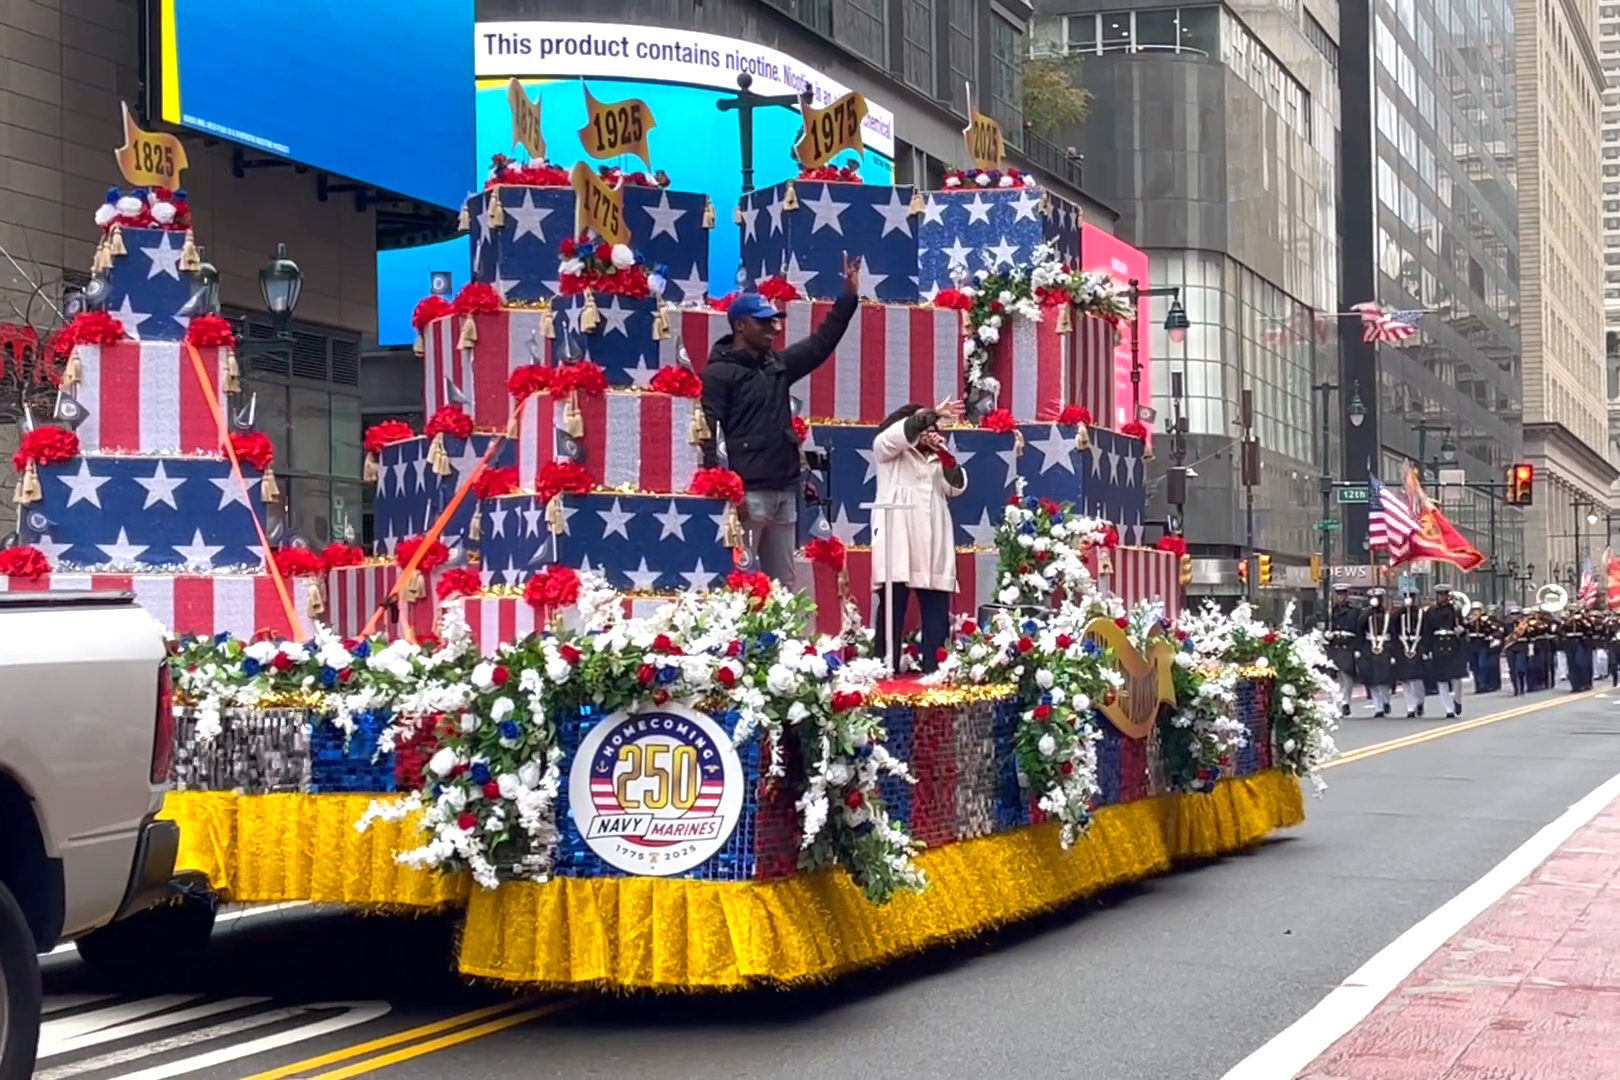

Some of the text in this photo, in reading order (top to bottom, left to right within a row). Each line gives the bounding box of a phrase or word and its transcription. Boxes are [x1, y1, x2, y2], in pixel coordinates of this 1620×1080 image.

[483, 33, 532, 55] This
[540, 34, 629, 60] product
[636, 41, 720, 68] contains
[593, 104, 642, 151] 1925
[811, 96, 858, 161] 1975
[973, 120, 999, 163] 2025
[133, 139, 175, 177] 1825
[584, 179, 619, 236] 1775
[1343, 490, 1366, 499] 12th
[603, 718, 714, 760] HOMECOMING
[617, 744, 698, 810] 250
[597, 817, 716, 837] NAVY MARINES
[615, 844, 696, 861] 1775 2025
